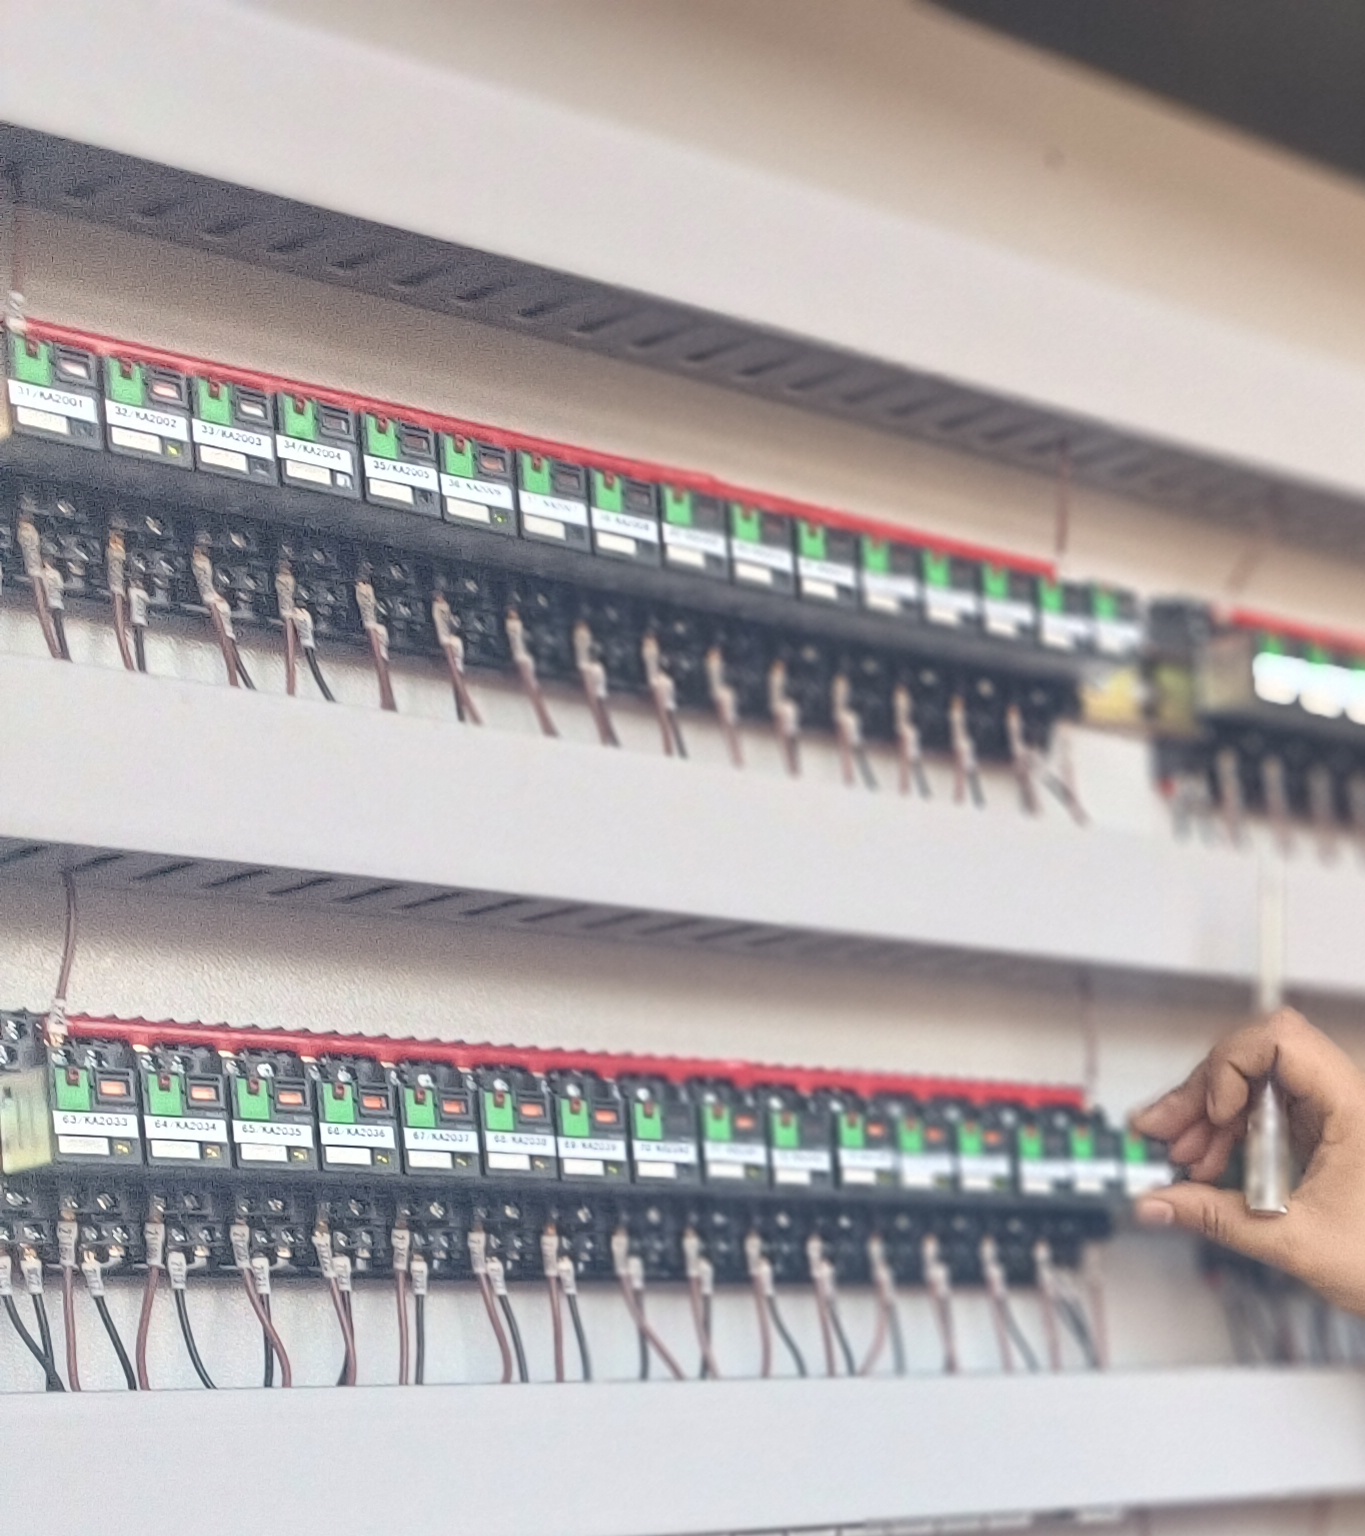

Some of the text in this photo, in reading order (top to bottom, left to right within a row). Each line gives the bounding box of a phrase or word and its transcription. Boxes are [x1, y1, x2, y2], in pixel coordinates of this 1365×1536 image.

[113, 405, 177, 429] 32/KA2002
[201, 424, 262, 447] 33/KA2003
[61, 1113, 129, 1128] 63/KA2033
